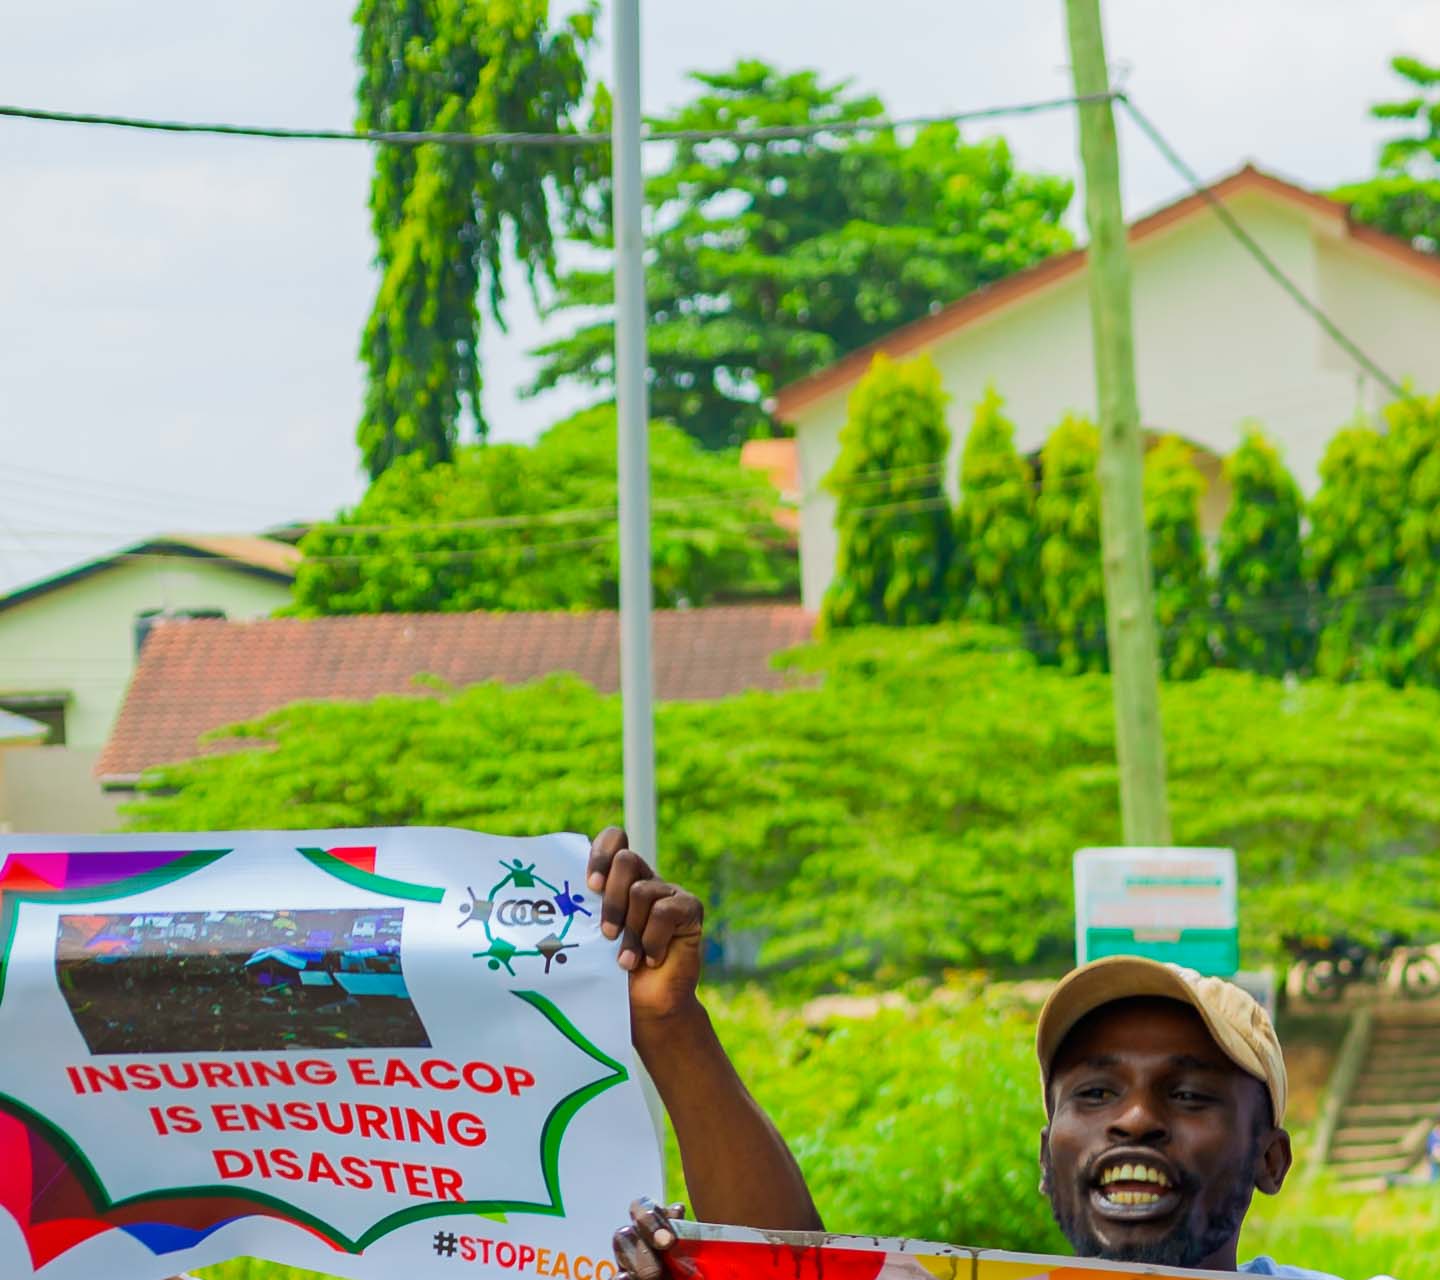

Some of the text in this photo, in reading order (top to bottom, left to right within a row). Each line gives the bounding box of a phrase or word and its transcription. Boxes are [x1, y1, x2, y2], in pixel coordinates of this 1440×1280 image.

[66, 1059, 536, 1098] INSURING EACOP
[148, 1102, 487, 1147] IS ENSURING
[212, 1148, 467, 1203] DISASTER
